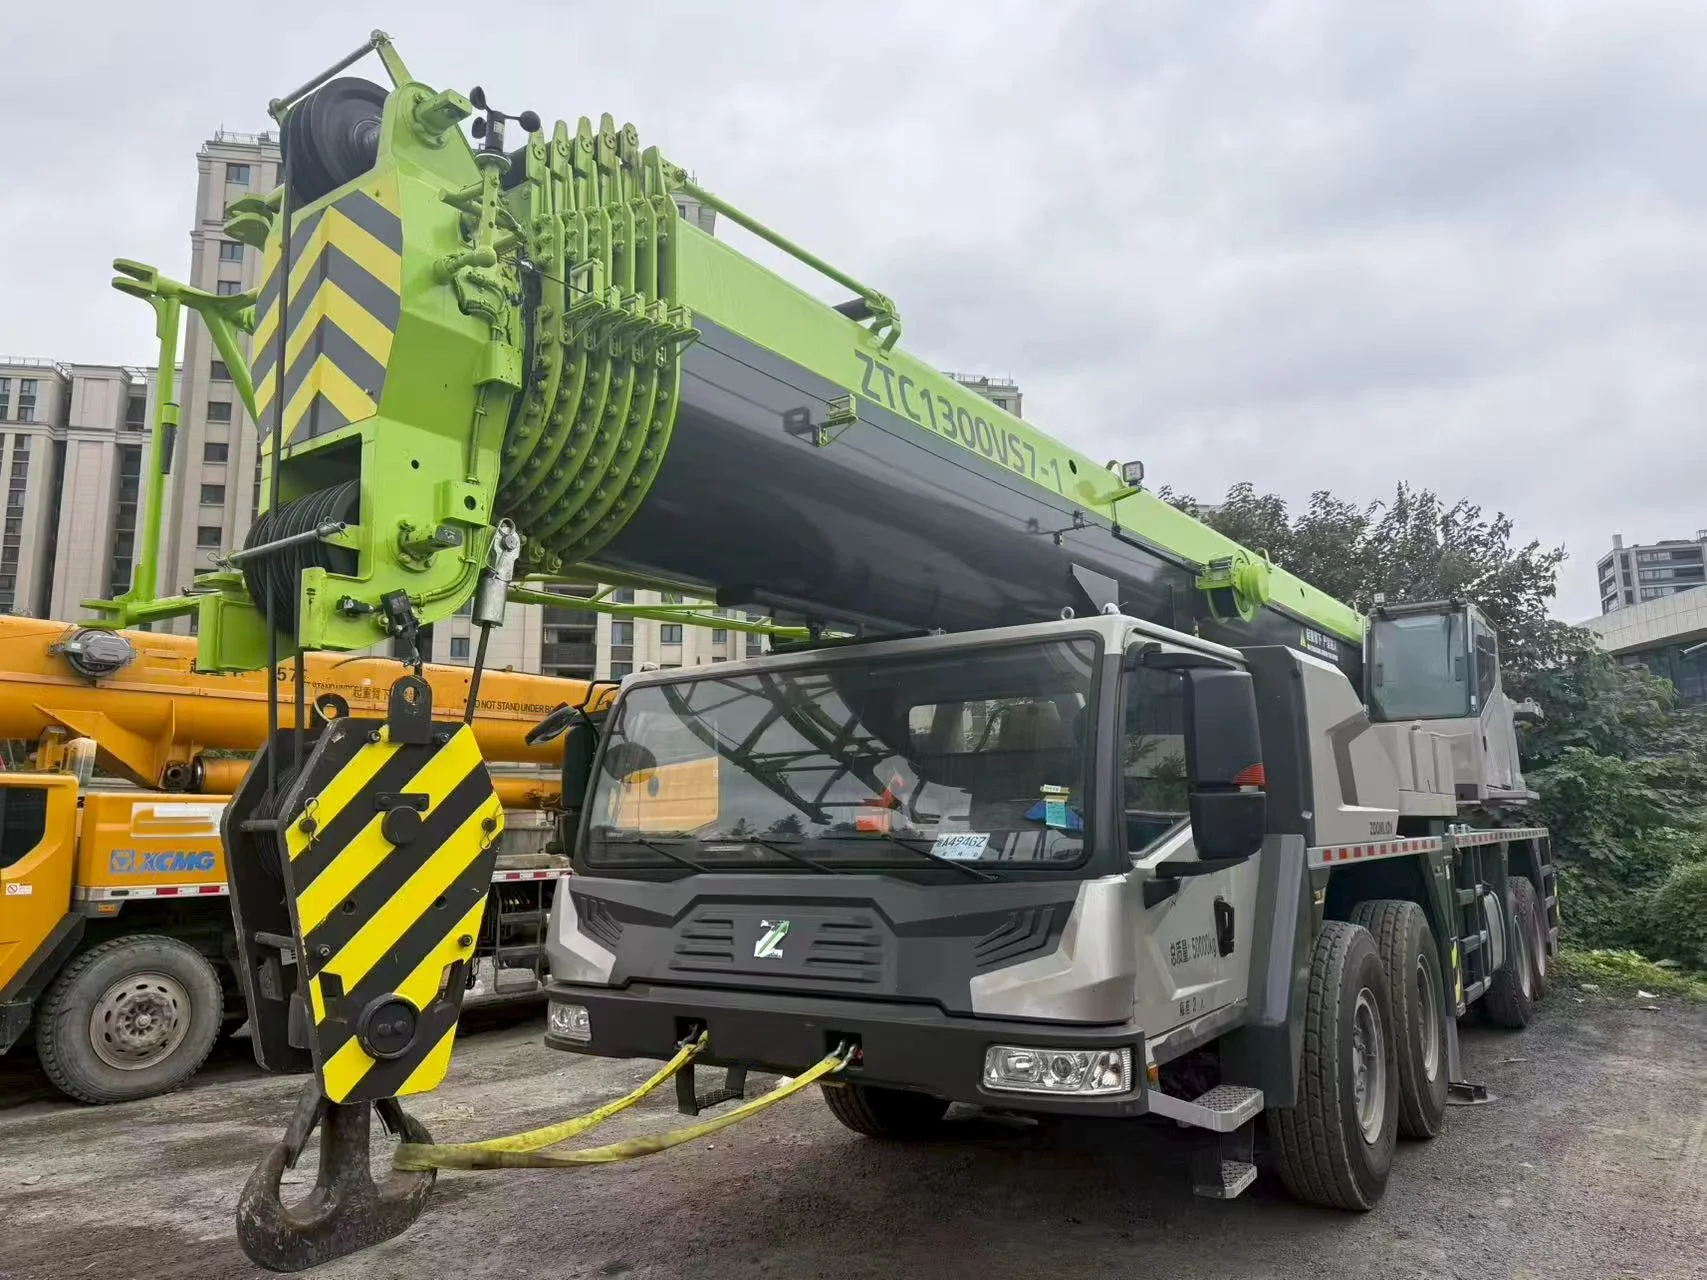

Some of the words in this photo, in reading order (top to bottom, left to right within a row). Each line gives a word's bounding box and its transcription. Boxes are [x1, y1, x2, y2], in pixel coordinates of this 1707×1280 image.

[481, 700, 496, 710] NOT
[497, 702, 520, 711] STAND
[522, 703, 544, 713] UNDER
[138, 850, 216, 873] XCMG
